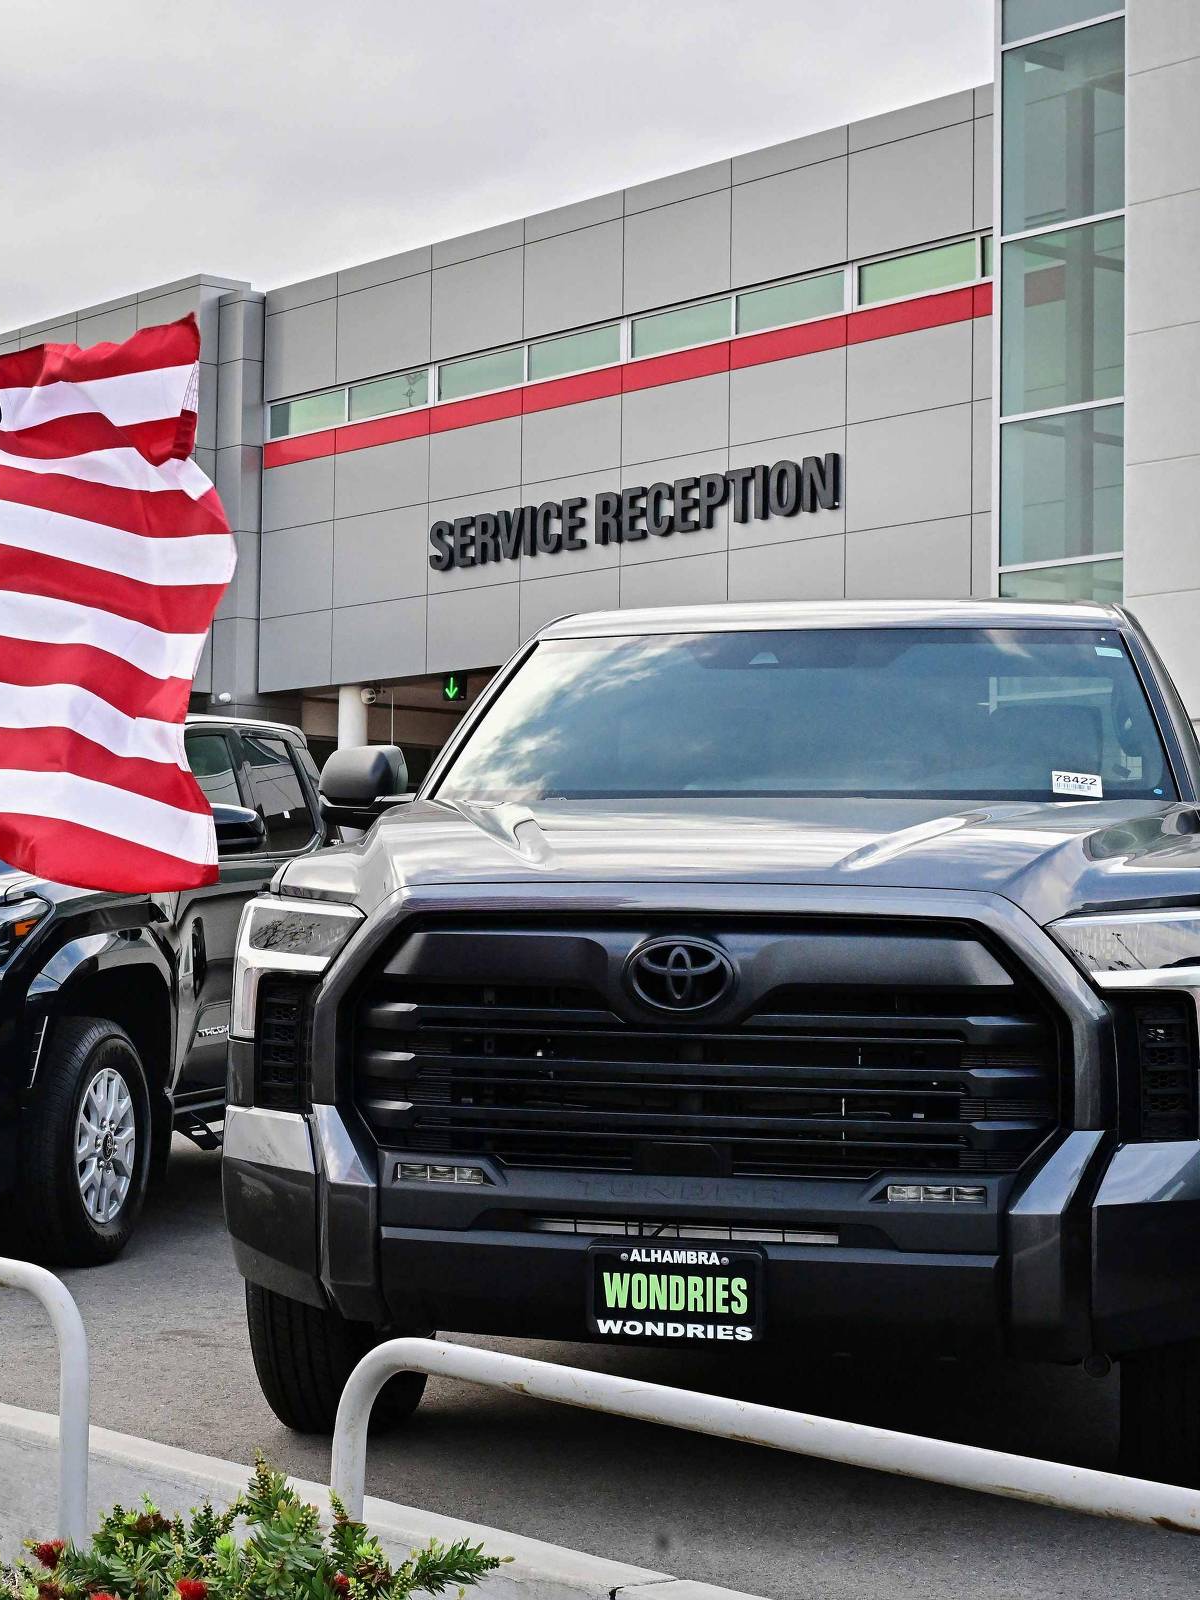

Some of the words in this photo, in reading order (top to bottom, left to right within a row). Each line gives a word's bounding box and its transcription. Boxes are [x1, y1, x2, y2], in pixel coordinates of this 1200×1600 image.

[429, 496, 587, 571] SERVICE
[594, 452, 841, 545] RECEPTION
[1054, 774, 1098, 786] 78422
[629, 1248, 721, 1266] ALHAMBRA
[603, 1271, 748, 1315] WONDRIES
[596, 1319, 753, 1341] WONDRIES
